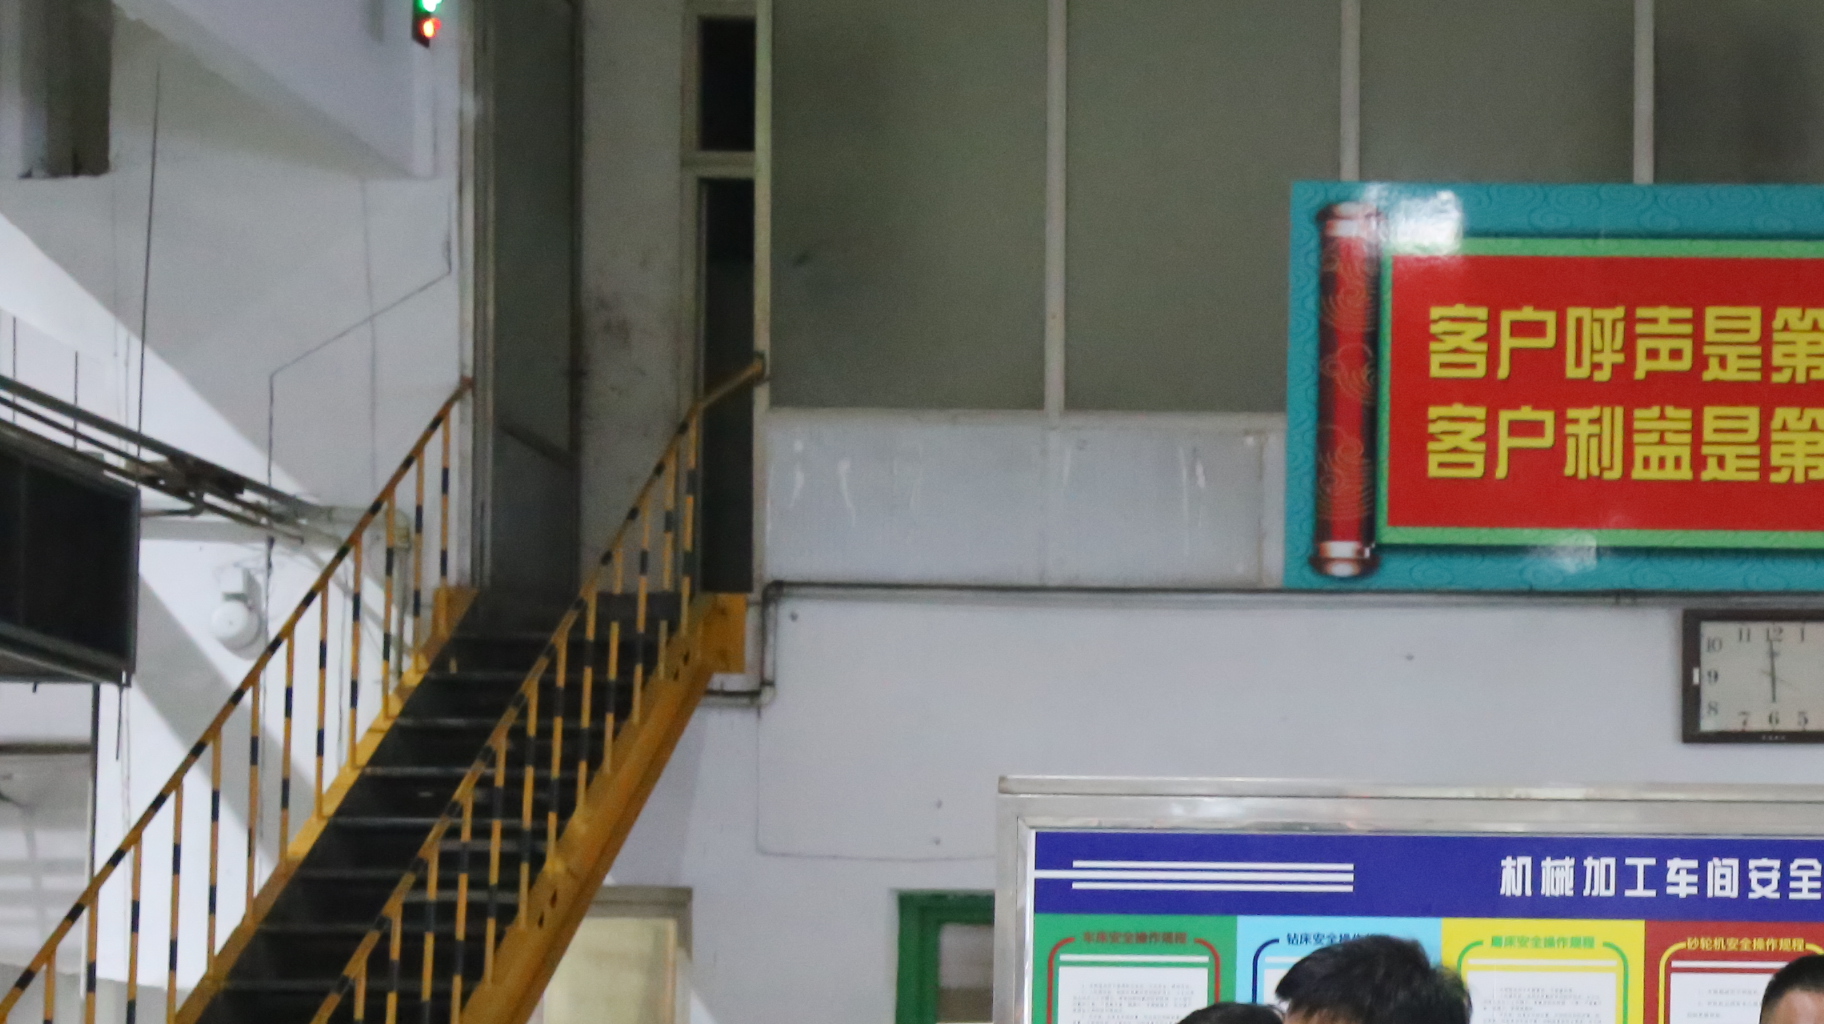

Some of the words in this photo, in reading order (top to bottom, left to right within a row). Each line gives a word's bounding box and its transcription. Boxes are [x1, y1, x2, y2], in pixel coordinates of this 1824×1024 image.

[1686, 937, 1806, 952] 砂轮机安全操作规程
